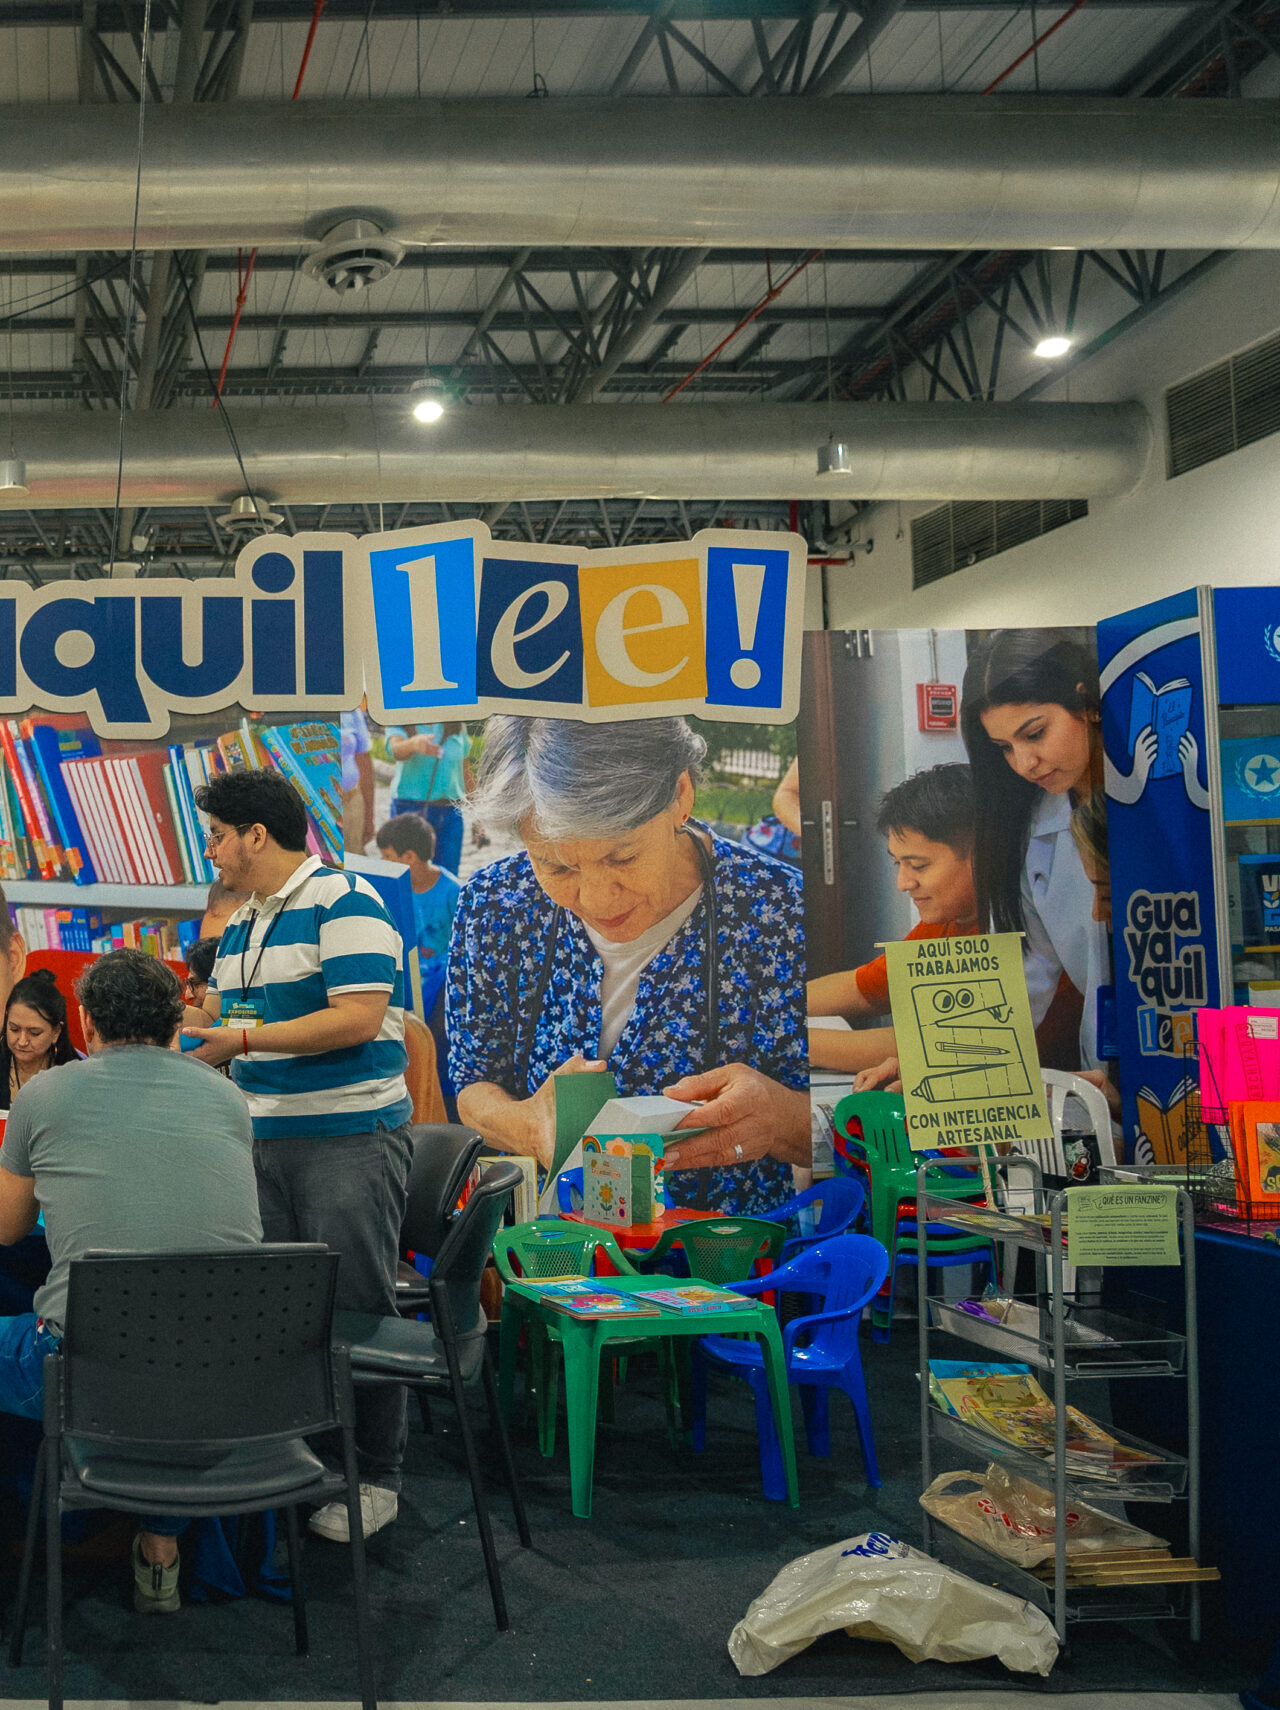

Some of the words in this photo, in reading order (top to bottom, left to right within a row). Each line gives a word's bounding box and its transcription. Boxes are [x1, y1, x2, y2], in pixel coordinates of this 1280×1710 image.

[395, 554, 766, 690] lee!
[1130, 895, 1197, 932] Gua
[917, 938, 951, 959] AQUÍ
[955, 939, 989, 955] SOLO
[1127, 932, 1172, 976] ya
[907, 956, 999, 977] TRABAJAMOS
[1141, 951, 1204, 1007] quil
[1144, 1012, 1192, 1050] lee
[910, 1113, 940, 1129] CON
[944, 1103, 1041, 1127] INTELIGENCIA
[937, 1124, 1022, 1146] ARTESANAL
[1115, 1195, 1124, 1205] ES
[1124, 1195, 1135, 1205] UN
